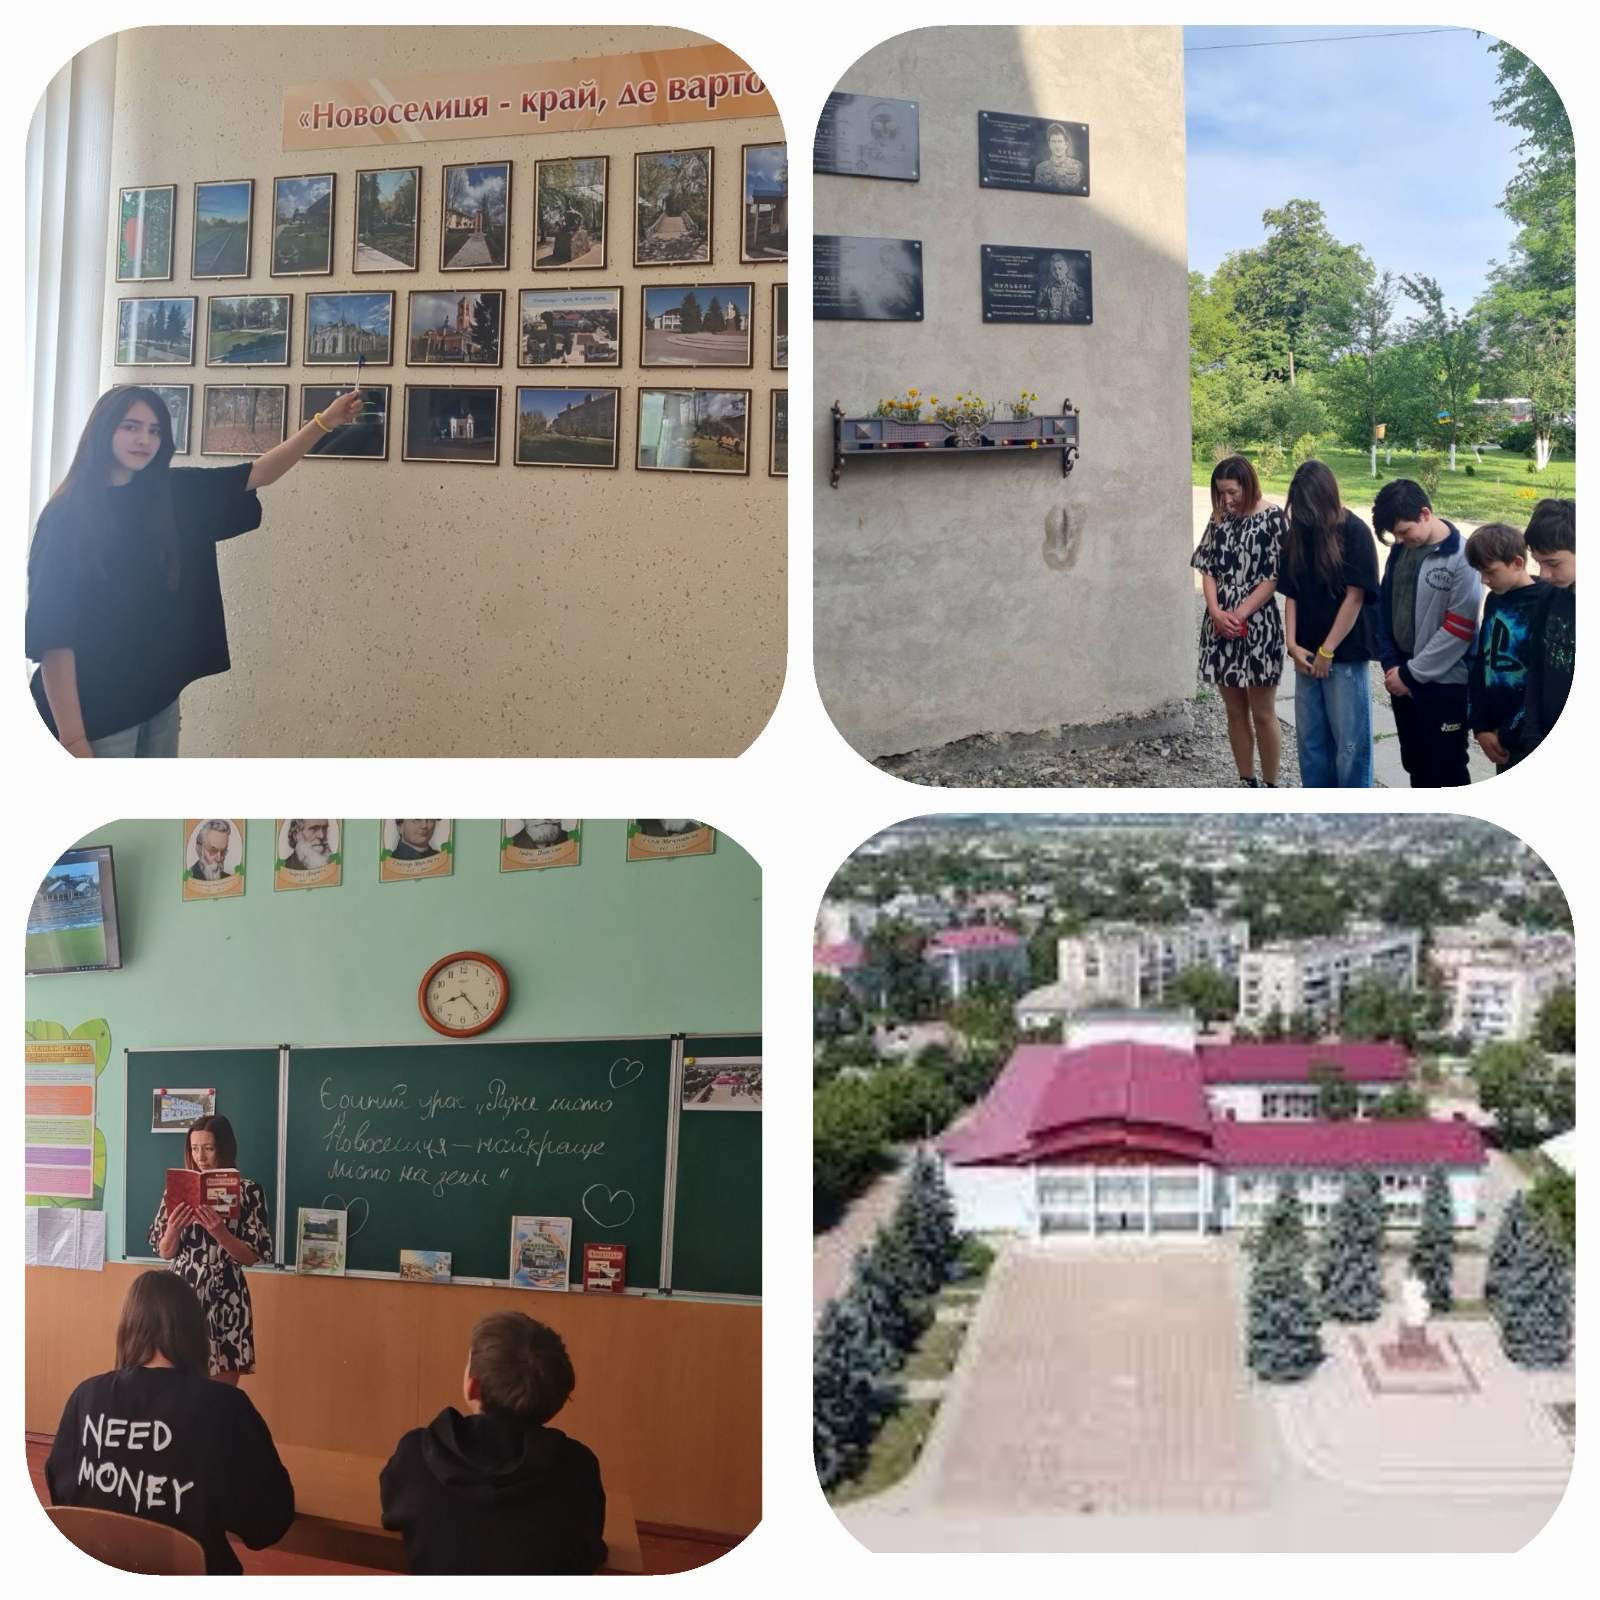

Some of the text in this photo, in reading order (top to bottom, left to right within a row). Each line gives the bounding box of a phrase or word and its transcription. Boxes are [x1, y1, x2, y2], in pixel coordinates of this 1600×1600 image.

[298, 72, 766, 130] «Новоселиця - край, де варто
[399, 1164, 431, 1185] на
[82, 1413, 173, 1459] NEED
[78, 1456, 195, 1515] MONEY
